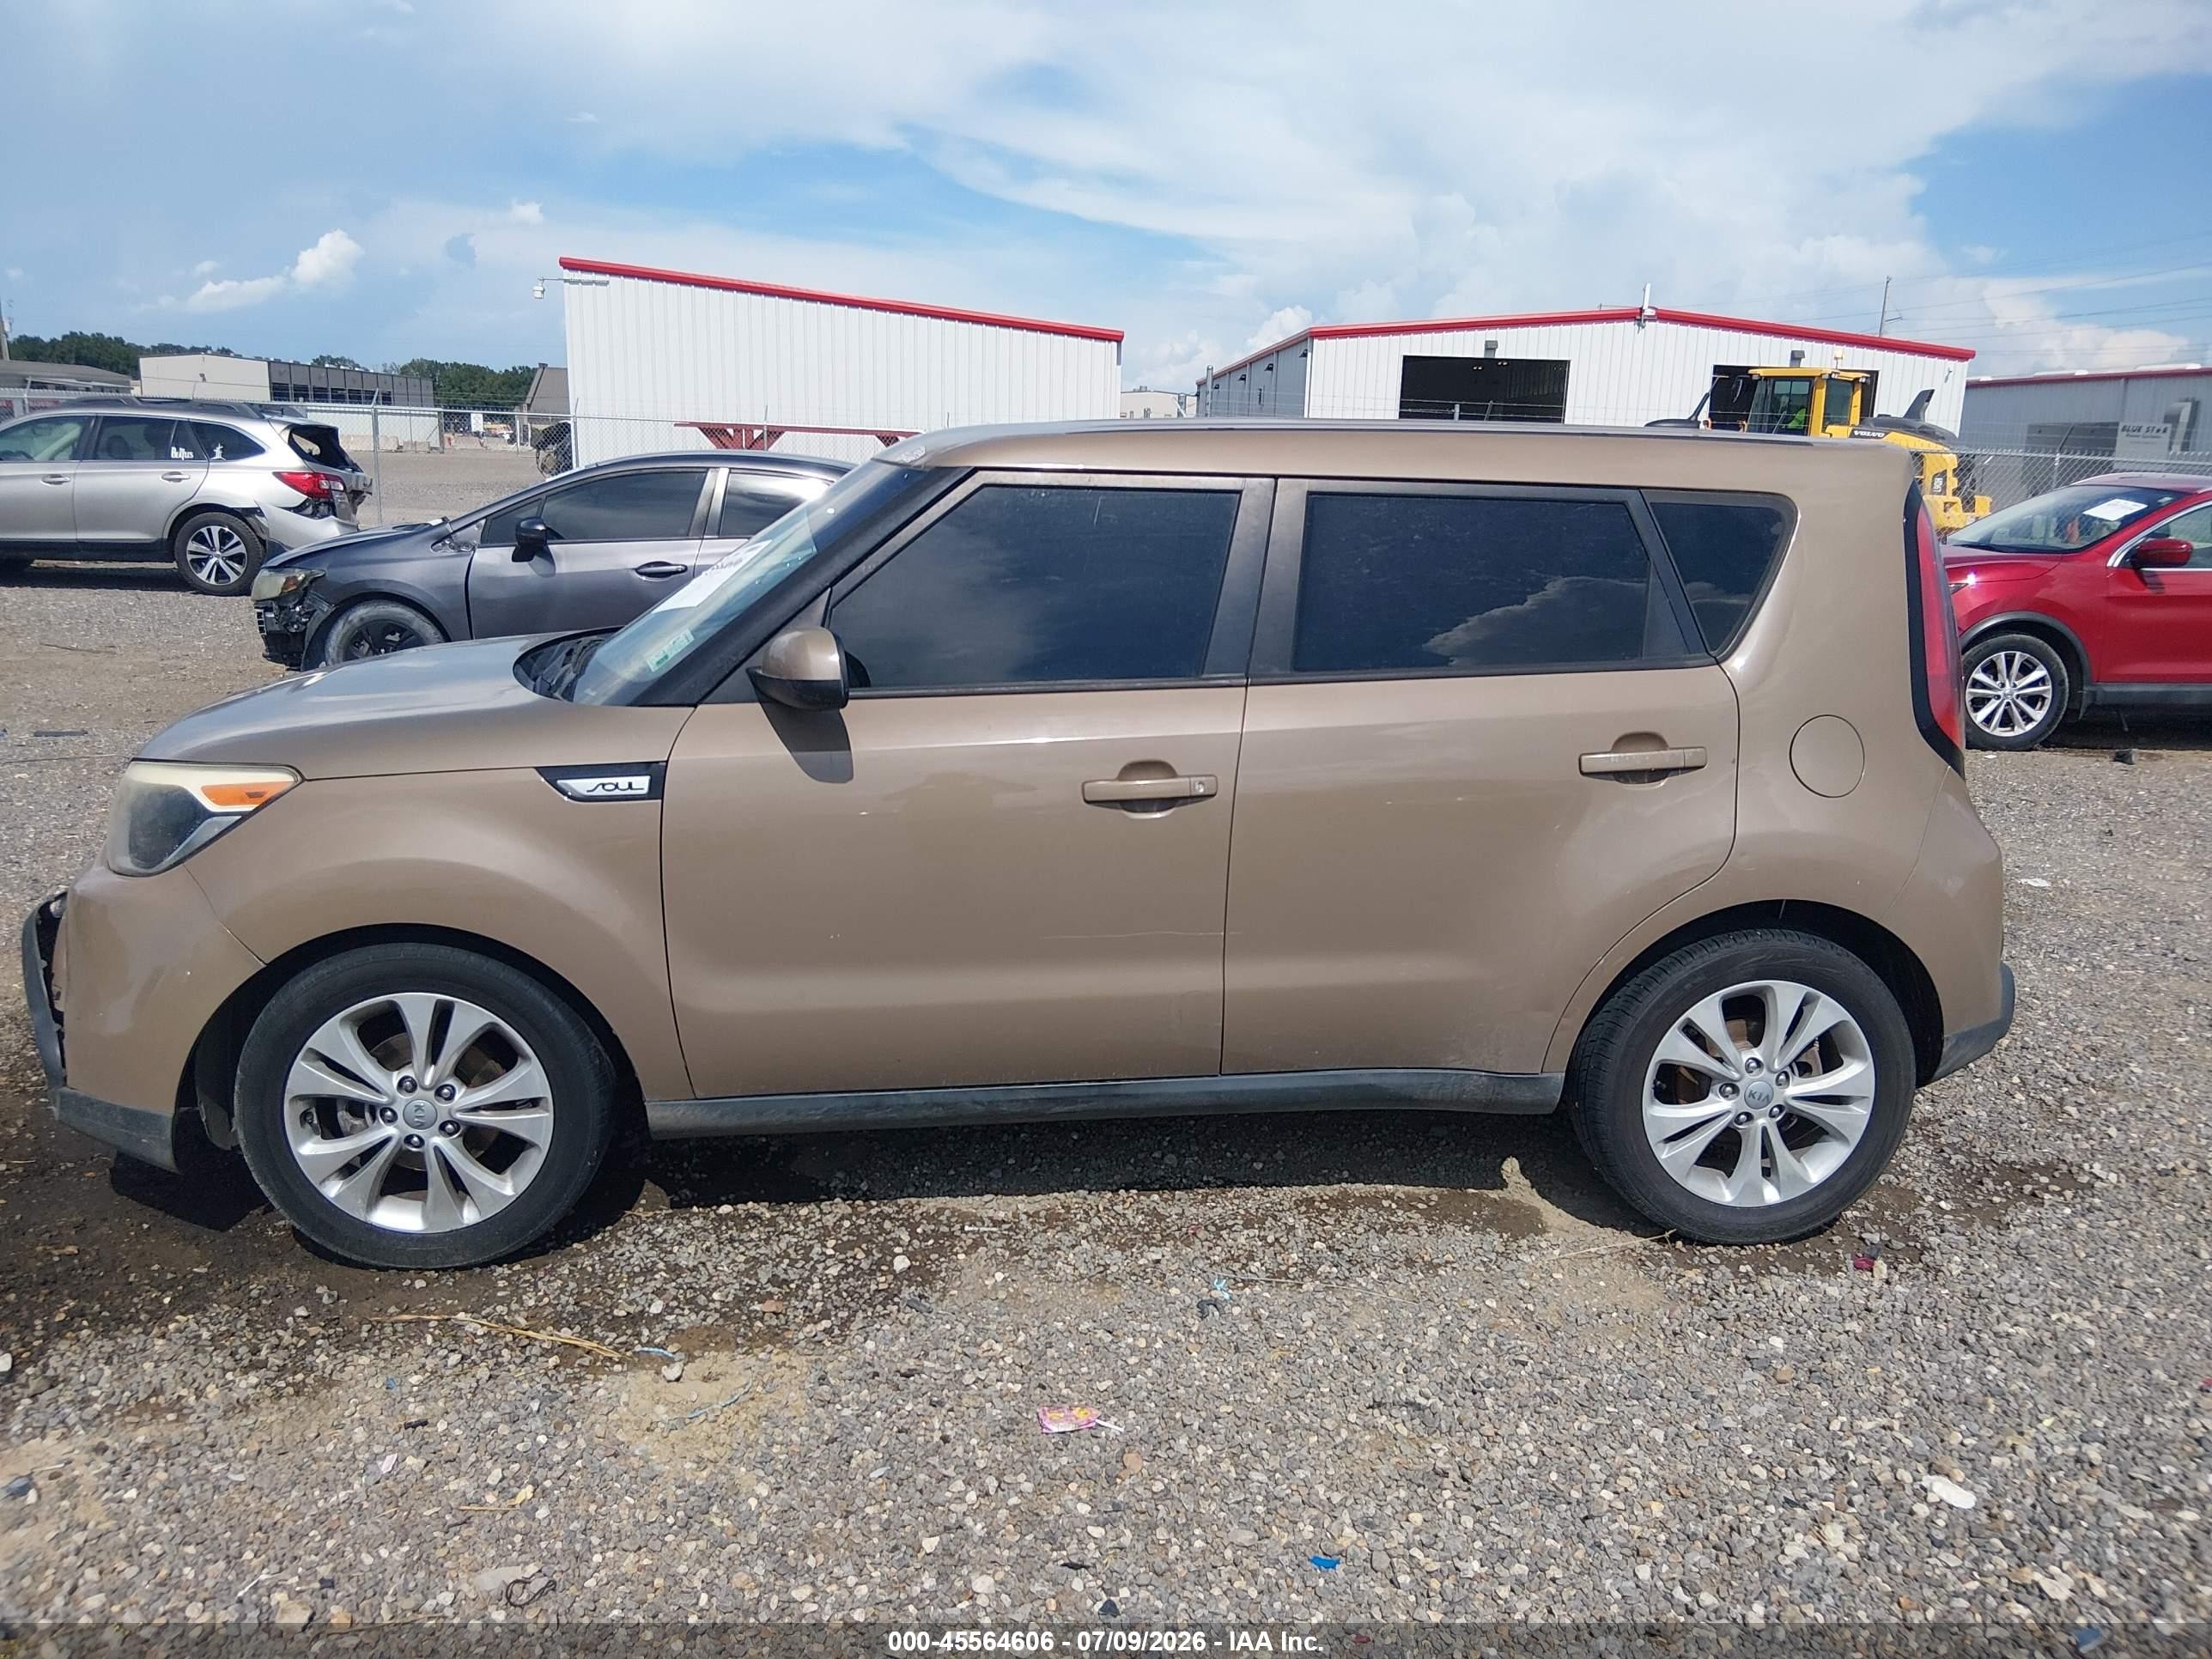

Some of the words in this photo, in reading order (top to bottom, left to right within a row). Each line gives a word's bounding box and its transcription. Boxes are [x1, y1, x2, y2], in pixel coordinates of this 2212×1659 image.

[2121, 425, 2144, 434] BLUE
[586, 781, 645, 793] SOUL
[1747, 1090, 1770, 1104] KIA
[414, 1104, 426, 1127] KIA
